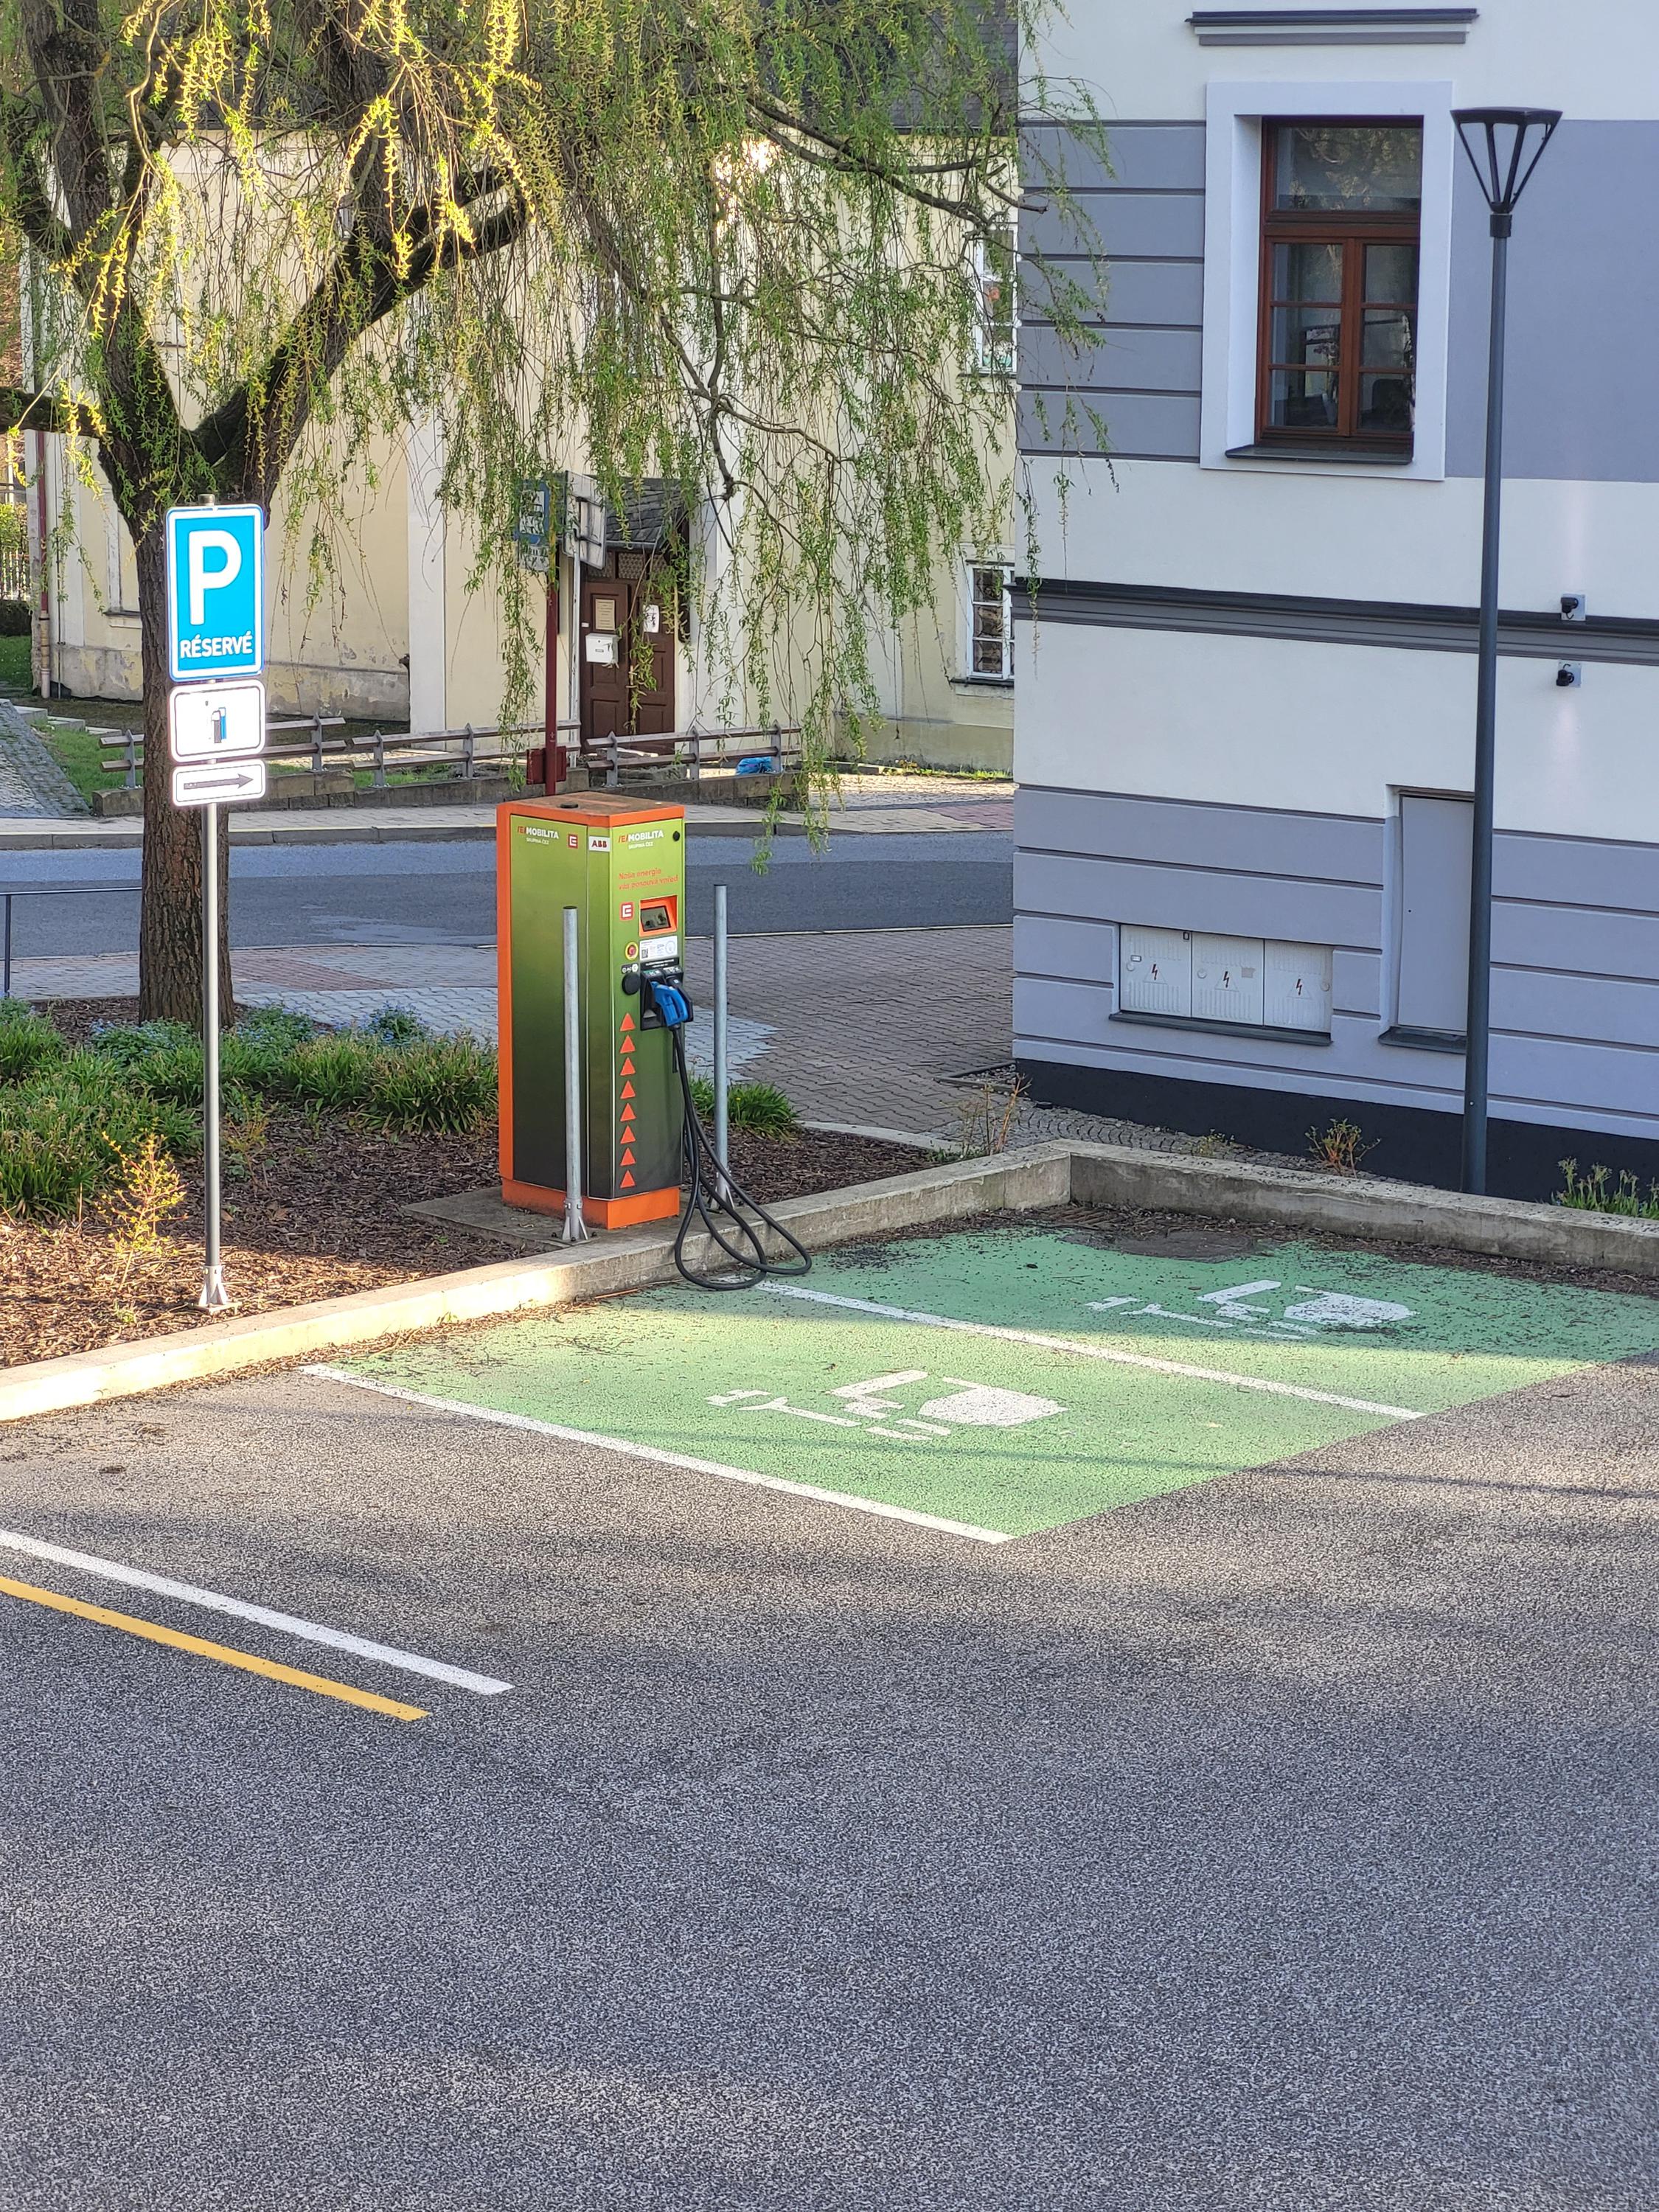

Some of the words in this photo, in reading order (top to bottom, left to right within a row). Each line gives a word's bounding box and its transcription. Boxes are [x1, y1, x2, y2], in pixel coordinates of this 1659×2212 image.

[188, 530, 242, 625] P
[180, 630, 253, 658] RÉSERVÉ
[591, 840, 608, 848] ABB
